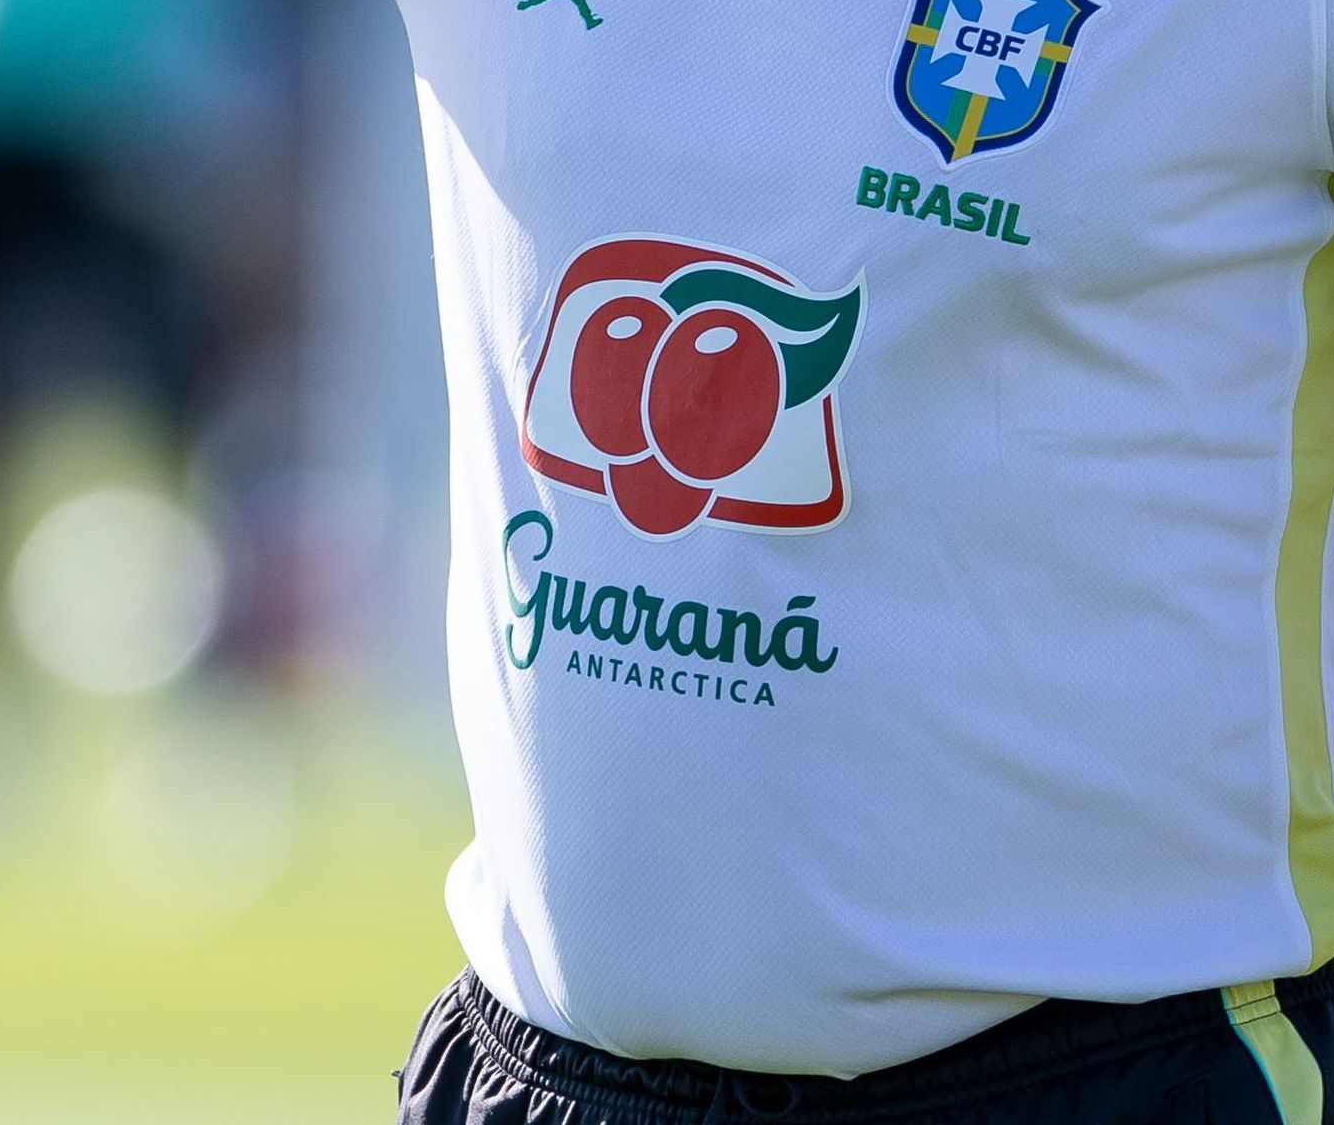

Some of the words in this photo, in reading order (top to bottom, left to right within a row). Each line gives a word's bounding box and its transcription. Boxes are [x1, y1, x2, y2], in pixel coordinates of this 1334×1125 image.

[954, 25, 1026, 61] CBF
[856, 166, 1031, 246] BRASIL
[503, 510, 839, 674] Guaraná
[566, 650, 776, 707] ANTARCTICA
